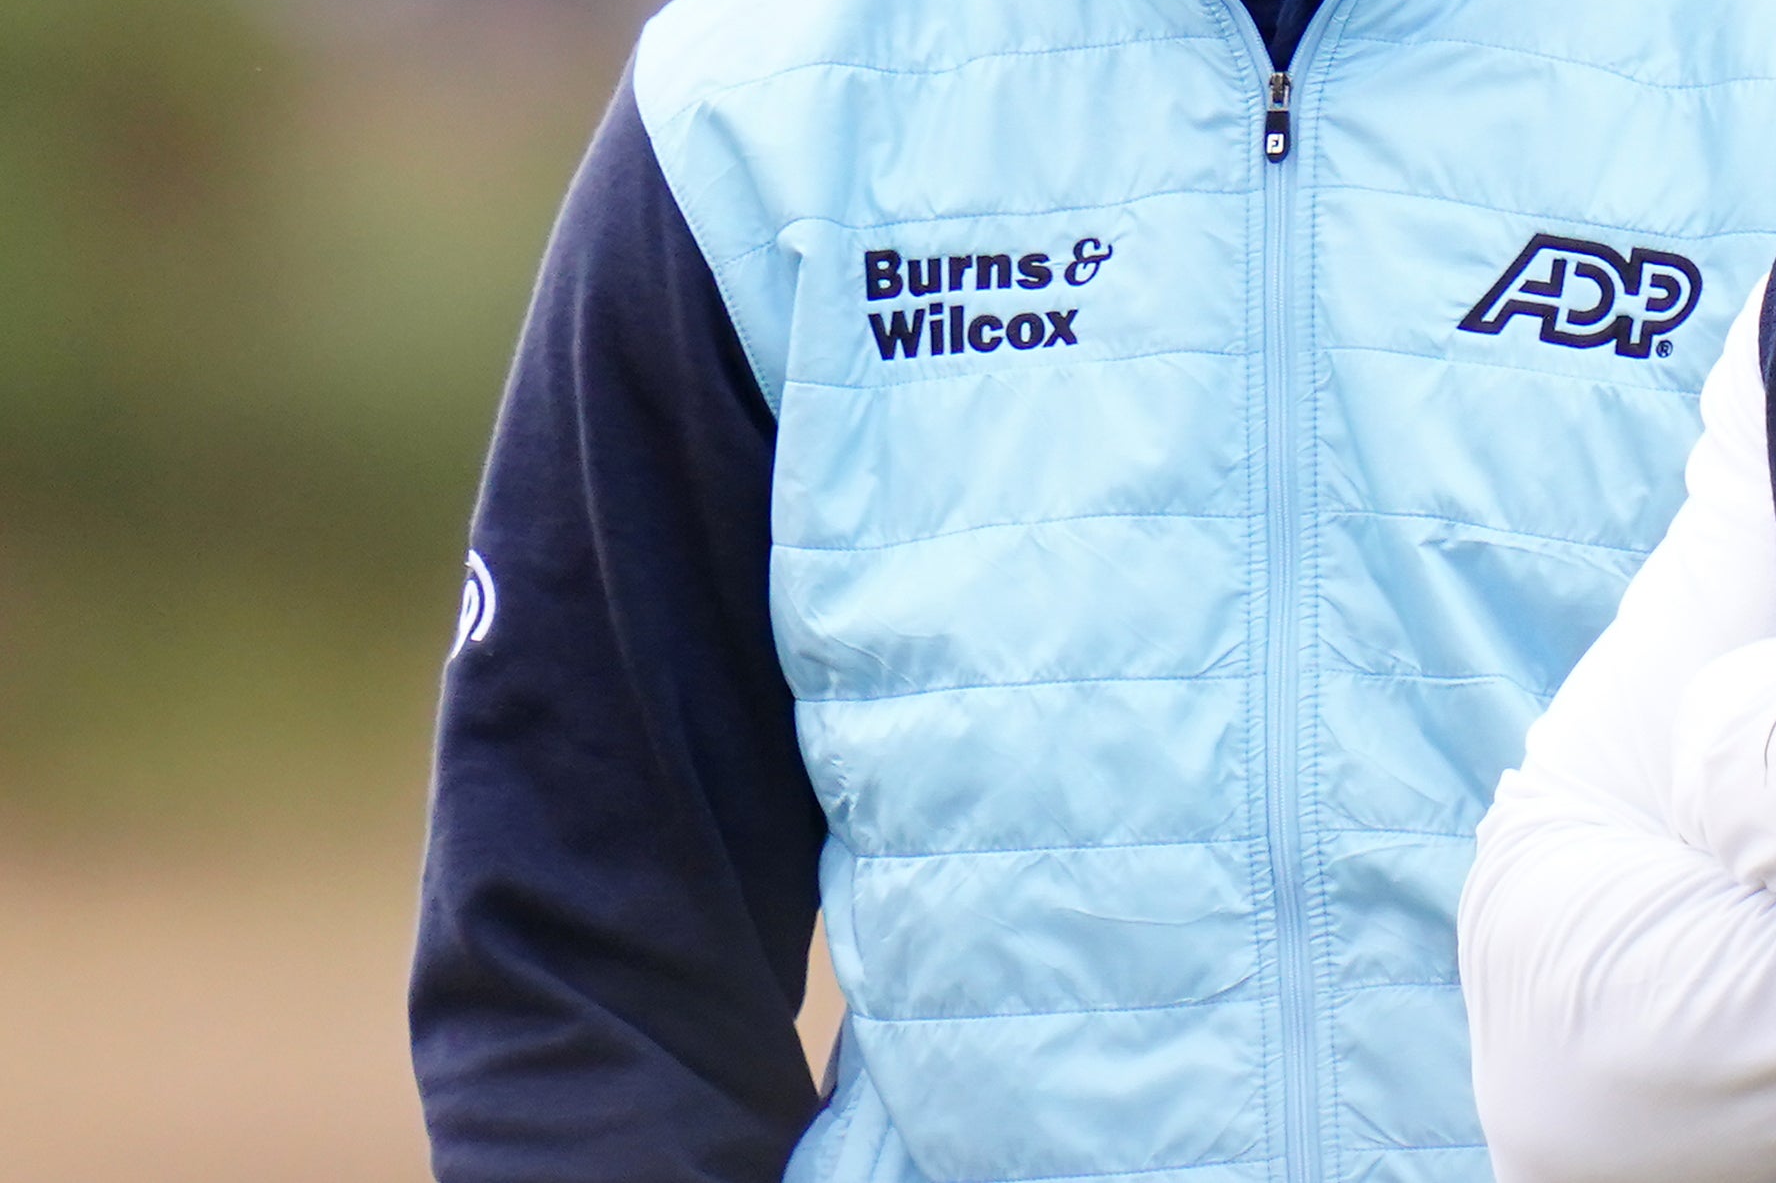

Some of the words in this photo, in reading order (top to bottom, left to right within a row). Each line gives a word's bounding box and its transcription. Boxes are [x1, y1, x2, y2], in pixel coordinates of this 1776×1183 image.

[864, 249, 1053, 302] Burns
[1064, 237, 1114, 287] &
[867, 302, 1079, 361] Wilcox
